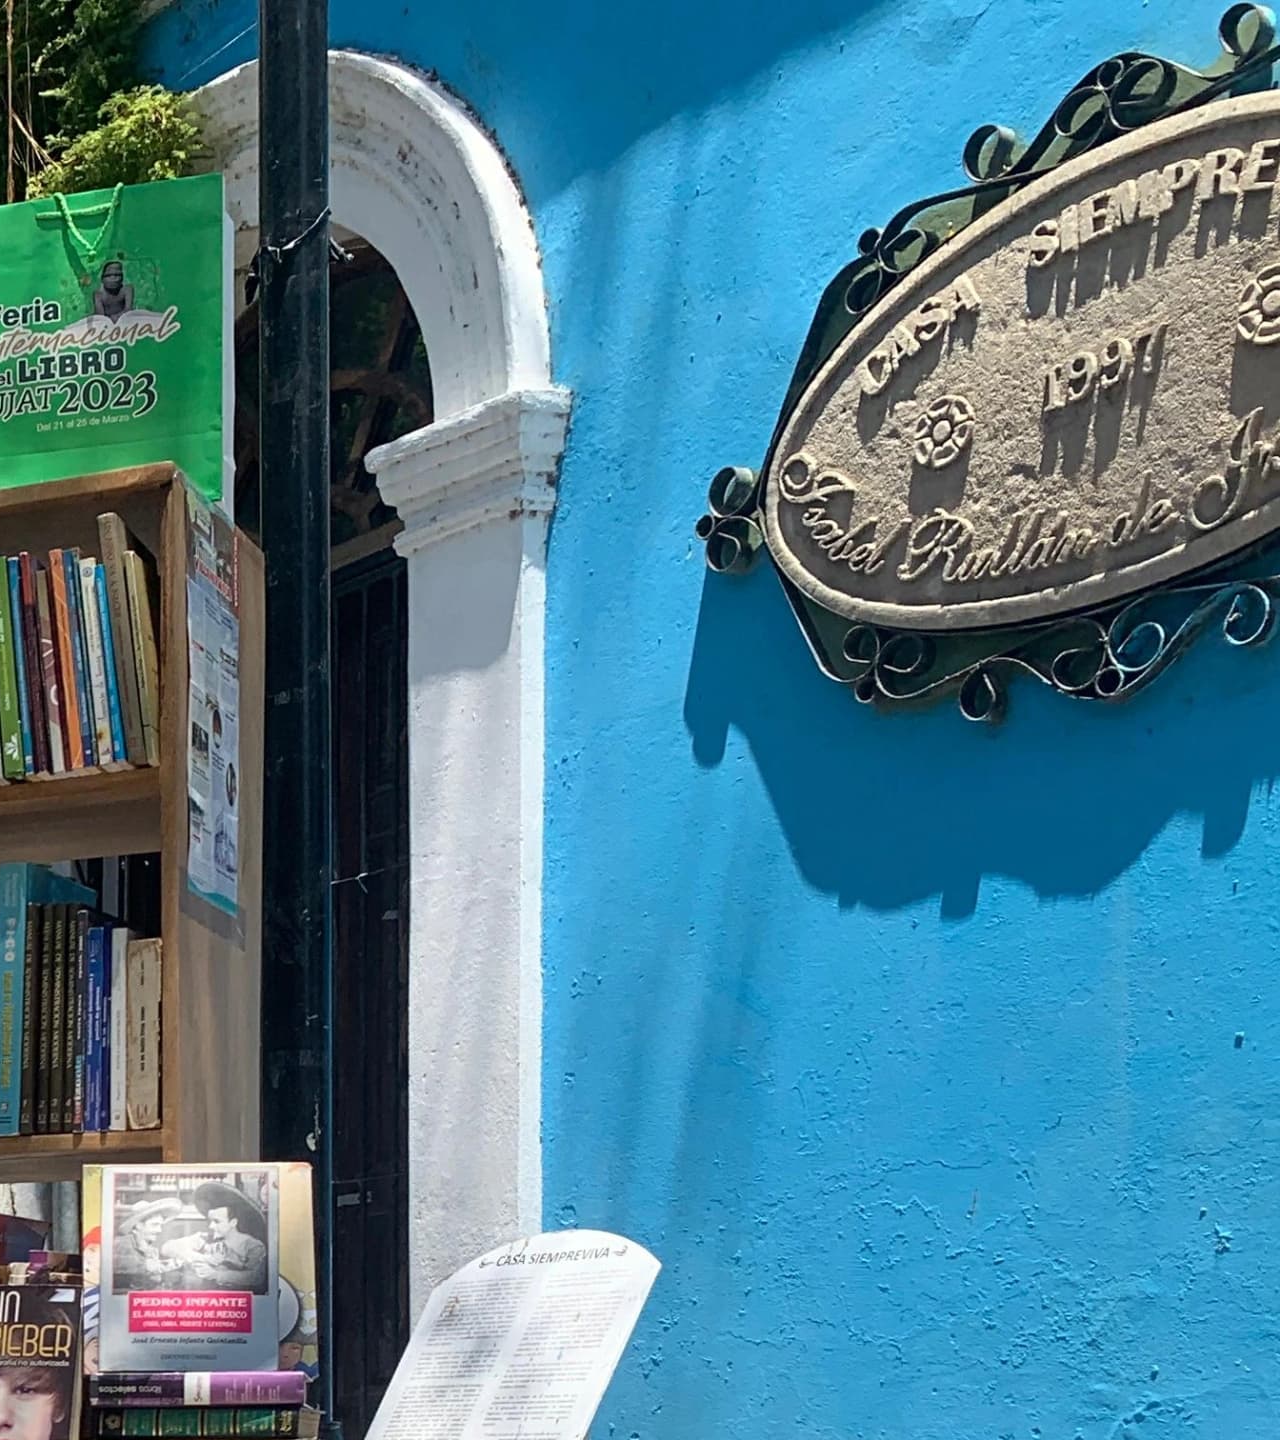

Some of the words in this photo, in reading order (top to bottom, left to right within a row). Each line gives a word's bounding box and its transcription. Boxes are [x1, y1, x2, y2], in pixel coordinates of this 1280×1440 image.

[859, 275, 981, 396] CASA
[18, 349, 126, 384] LIBRO
[1043, 323, 1168, 411] 1997
[57, 372, 157, 417] 2023
[495, 1253, 526, 1267] CASA
[527, 1247, 610, 1265] SIEMPREVIVA
[132, 1297, 182, 1307] PEDRO
[185, 1297, 248, 1307] INFANTE
[203, 1310, 215, 1319] DE
[206, 1337, 248, 1345] Quintanilla
[98, 1385, 137, 1394] selectos
[138, 1385, 162, 1394] libros
